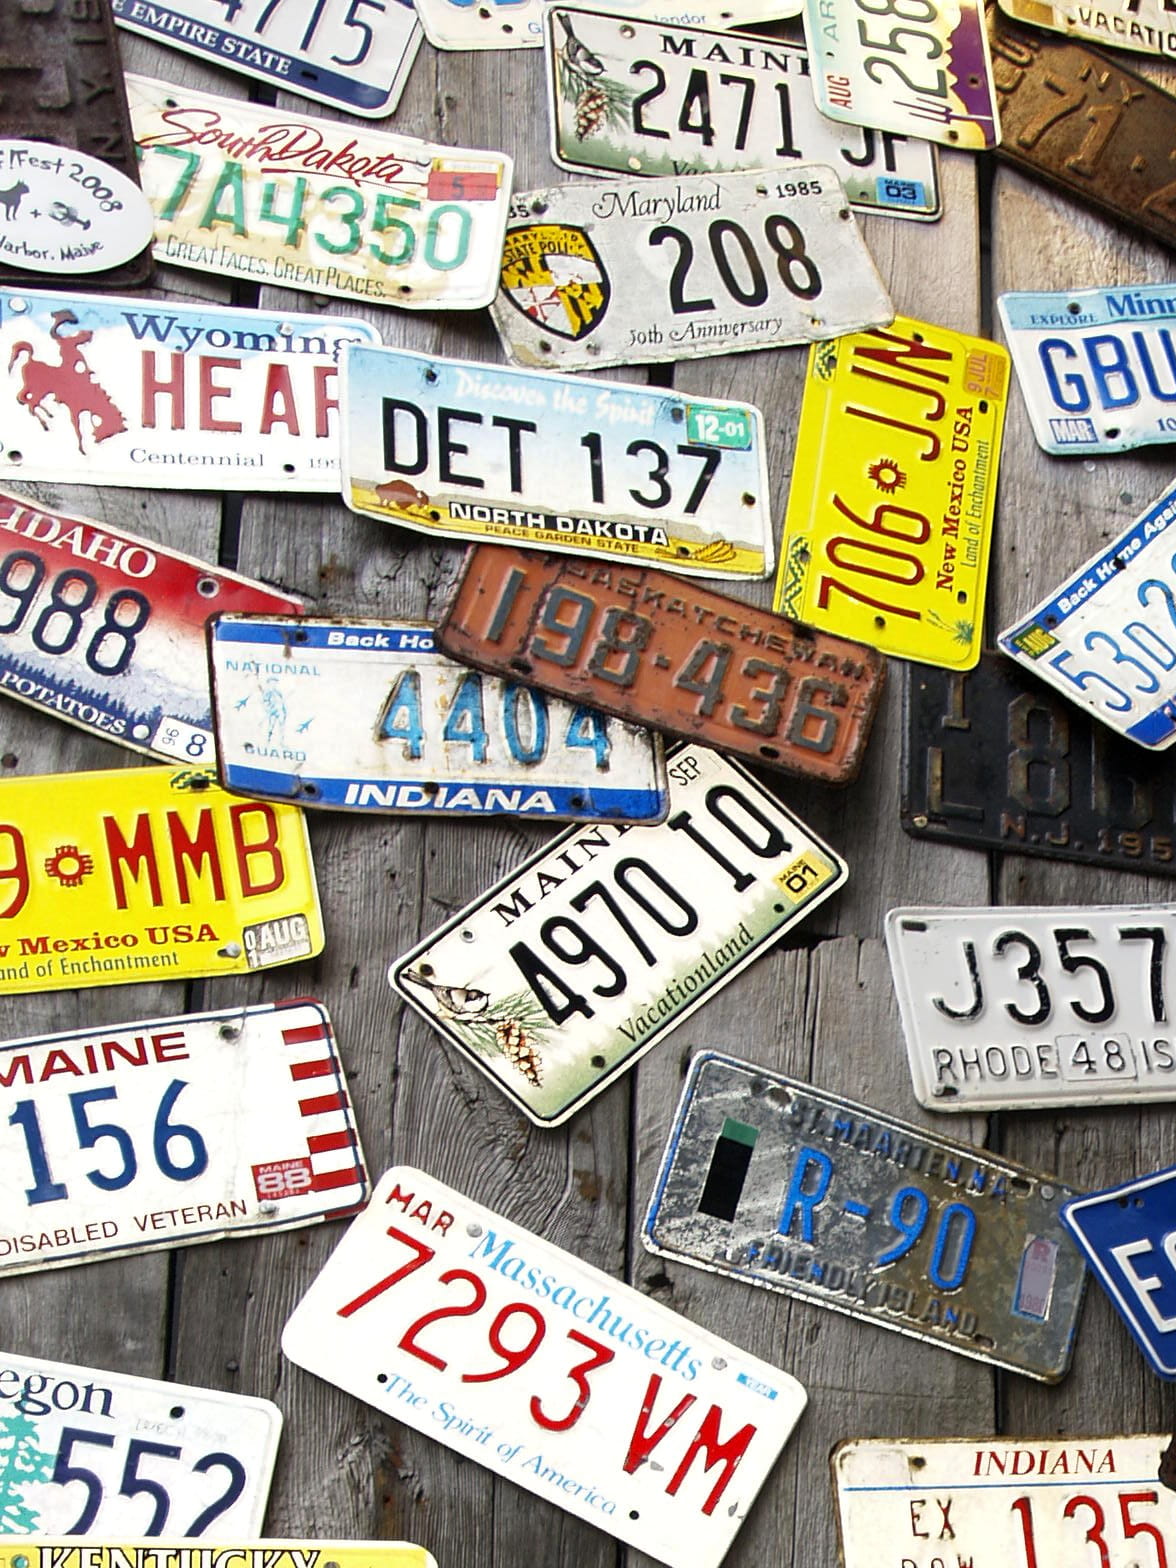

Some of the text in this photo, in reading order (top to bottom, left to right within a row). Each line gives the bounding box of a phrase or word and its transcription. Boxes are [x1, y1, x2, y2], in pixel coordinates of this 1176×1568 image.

[134, 2, 291, 76] EMPIRE STATE
[628, 60, 803, 158] 2471
[826, 73, 854, 110] AUG
[152, 143, 474, 272] 7A4350
[592, 181, 823, 224] Maryland 1985
[648, 213, 823, 315] 208
[121, 312, 363, 364] Wyoming
[668, 314, 784, 343] Anniversary
[693, 413, 746, 443] 12-01
[129, 447, 265, 470] Centennial
[381, 397, 722, 515] DET 137
[936, 404, 976, 593] New Mexico USA
[448, 501, 670, 548] NORTH DAKOTA
[534, 529, 594, 548] GARDEN
[817, 492, 933, 623] 706
[1056, 580, 1100, 616] Back
[327, 630, 391, 650] Back
[224, 658, 322, 678] NATIONAL
[0, 670, 130, 737] POTATOES
[243, 743, 309, 764] GUARD
[668, 757, 703, 788] SEP
[343, 783, 557, 814] INDIANA
[102, 800, 286, 912] MMB
[16, 922, 221, 958] Mexico USA
[59, 951, 181, 977] Enchantment
[508, 855, 700, 1027] 4970
[615, 921, 757, 1045] Vacationland
[934, 1043, 1058, 1083] RHODE
[1071, 1038, 1129, 1073] 48
[8, 1077, 210, 1207] 156
[0, 1199, 248, 1258] DISABLED VETERAN
[384, 1183, 456, 1239] MAR
[468, 1225, 705, 1384] Massachusetts
[336, 1225, 616, 1433] 7293
[621, 1372, 758, 1518] VM
[430, 1400, 619, 1518] Spirit America
[972, 1448, 1119, 1477] INDIANA
[909, 1497, 957, 1541] EX
